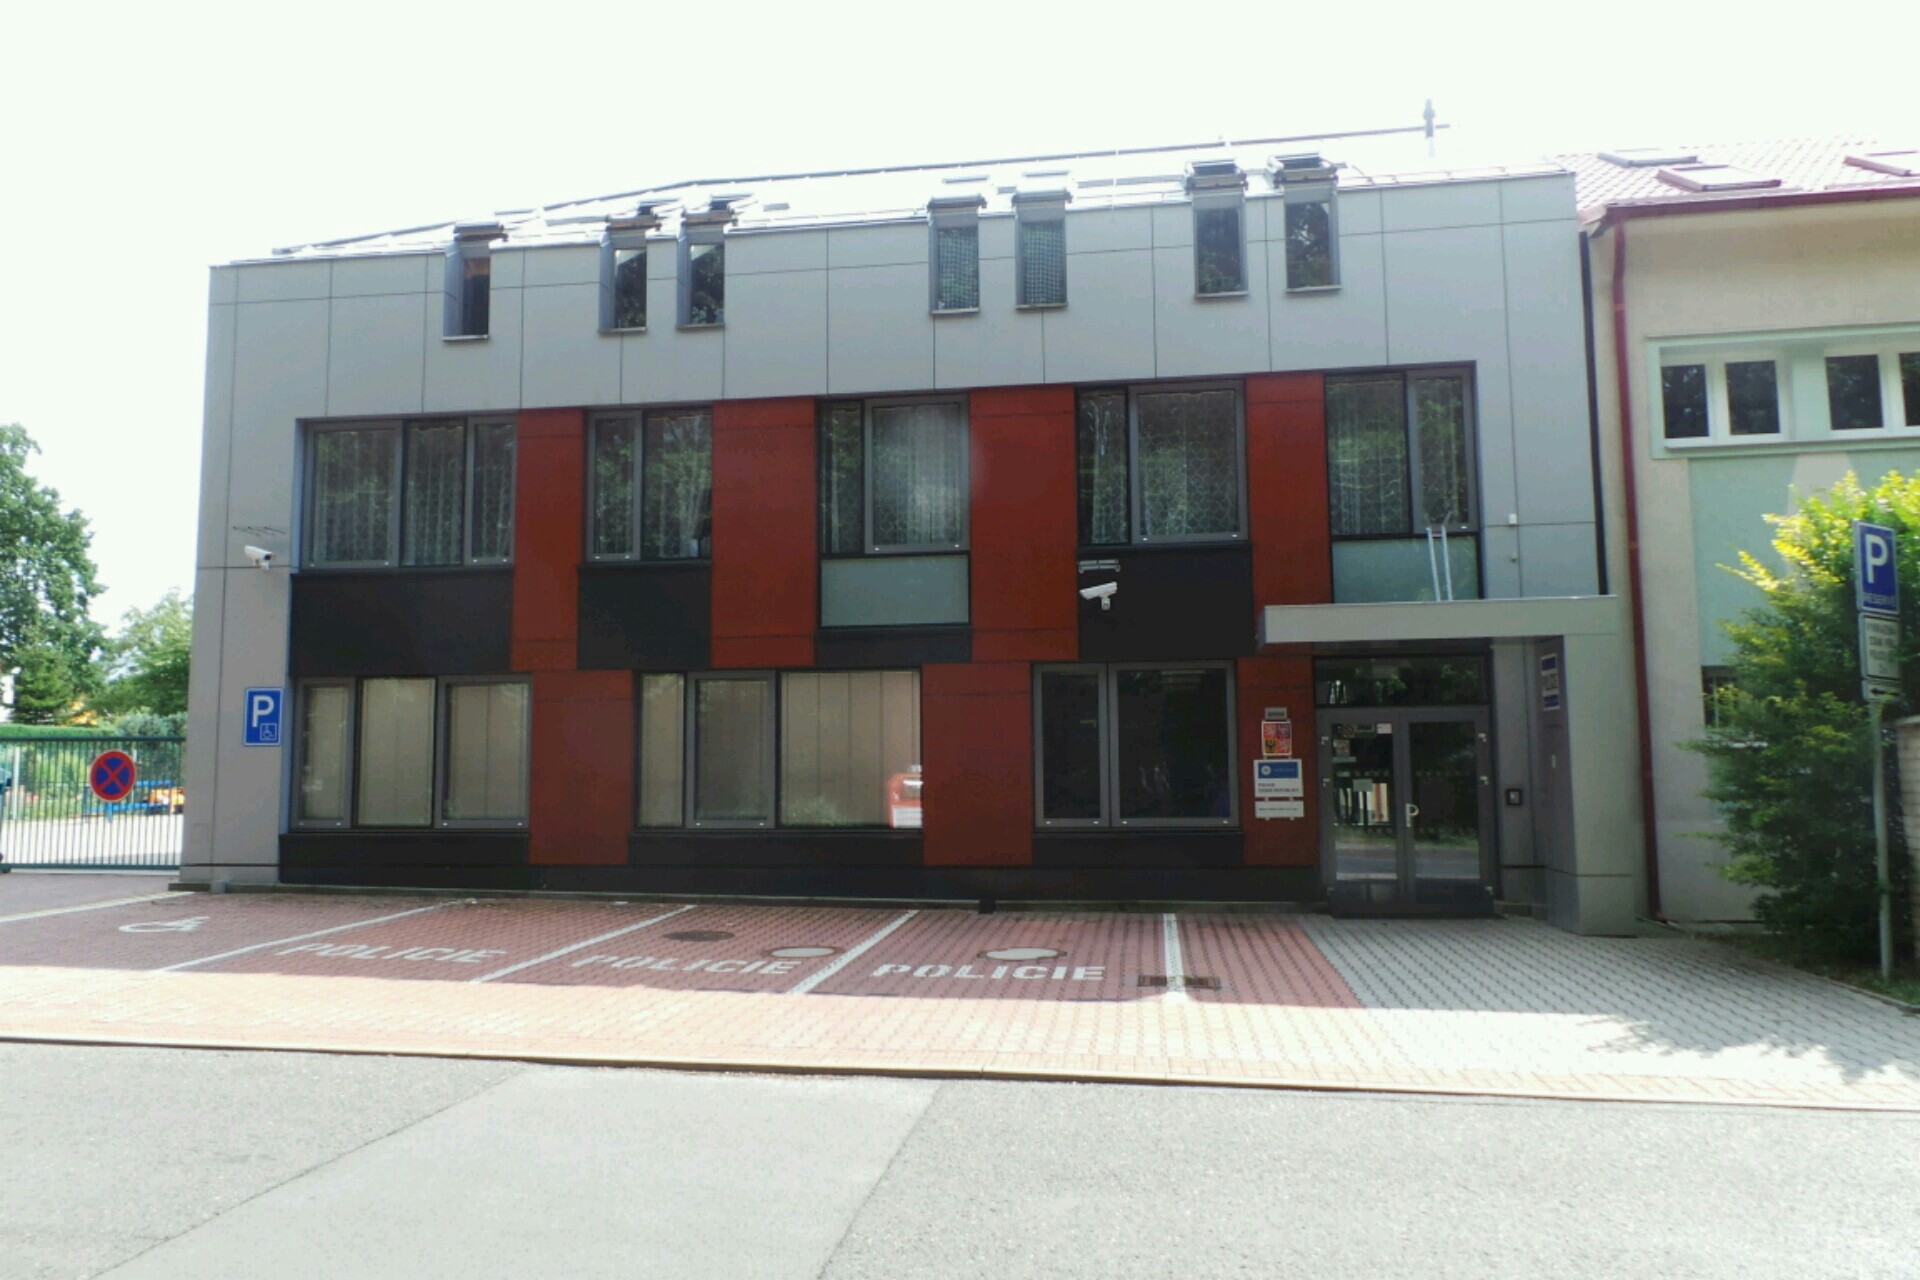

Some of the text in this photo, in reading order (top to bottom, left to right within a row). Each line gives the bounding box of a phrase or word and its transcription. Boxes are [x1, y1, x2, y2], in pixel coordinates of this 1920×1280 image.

[1865, 533, 1888, 584] P
[252, 695, 274, 727] P
[274, 943, 507, 963] POLICIE
[571, 954, 801, 974] POLICIE
[870, 964, 1106, 981] POLICIE
